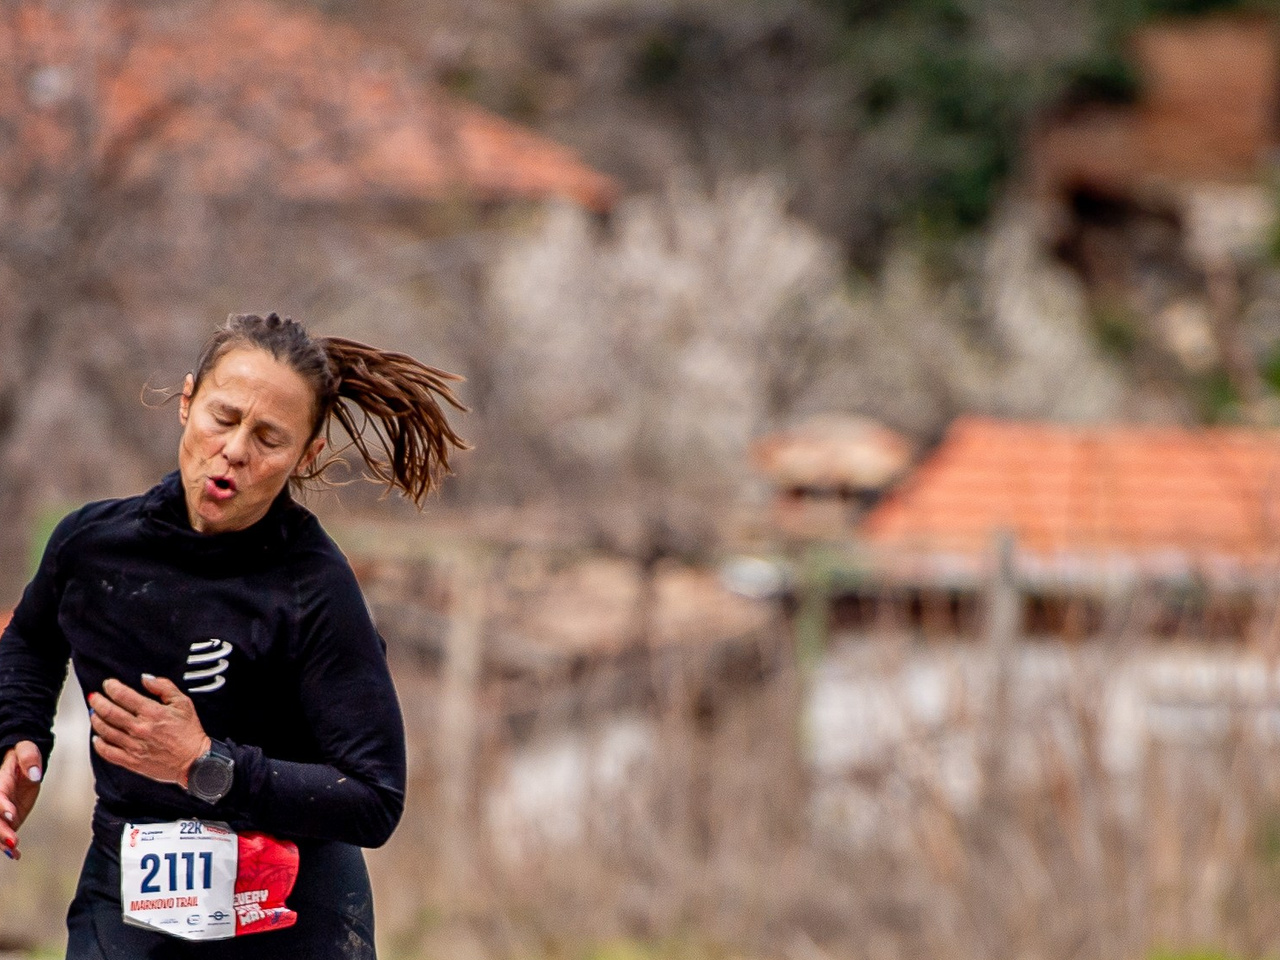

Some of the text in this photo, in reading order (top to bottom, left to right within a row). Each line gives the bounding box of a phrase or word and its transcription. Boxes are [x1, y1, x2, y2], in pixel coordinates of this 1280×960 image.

[180, 821, 202, 835] 22K
[140, 851, 214, 894] 2111
[130, 896, 199, 912] MARKOVO TRAIL
